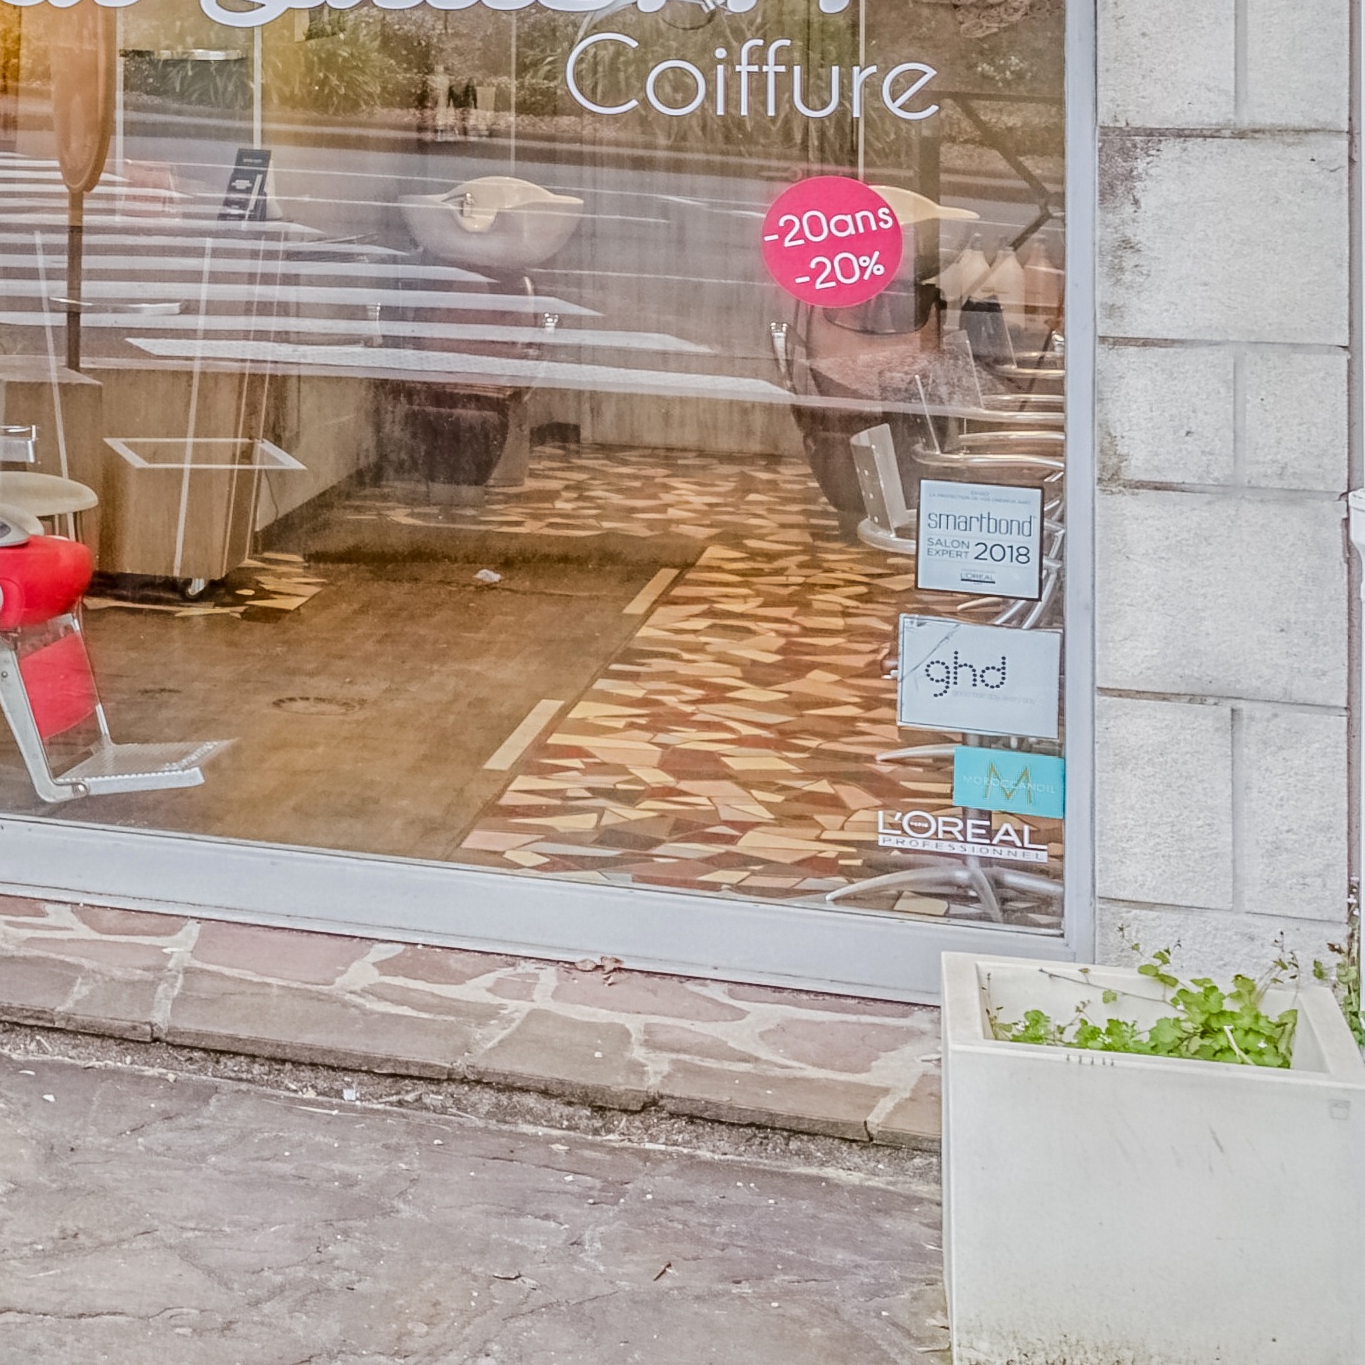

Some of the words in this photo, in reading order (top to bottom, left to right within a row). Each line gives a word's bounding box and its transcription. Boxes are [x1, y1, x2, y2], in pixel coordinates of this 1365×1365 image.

[565, 33, 939, 120] Coiffure
[763, 206, 894, 248] -20ans
[794, 250, 886, 290] -20%
[927, 511, 1032, 537] smartbond
[927, 537, 970, 549] SALON
[973, 541, 1031, 565] 2018
[927, 547, 970, 559] EXPERT
[924, 650, 1007, 698] ghd
[881, 836, 1045, 862] PROFESSIONNEL
